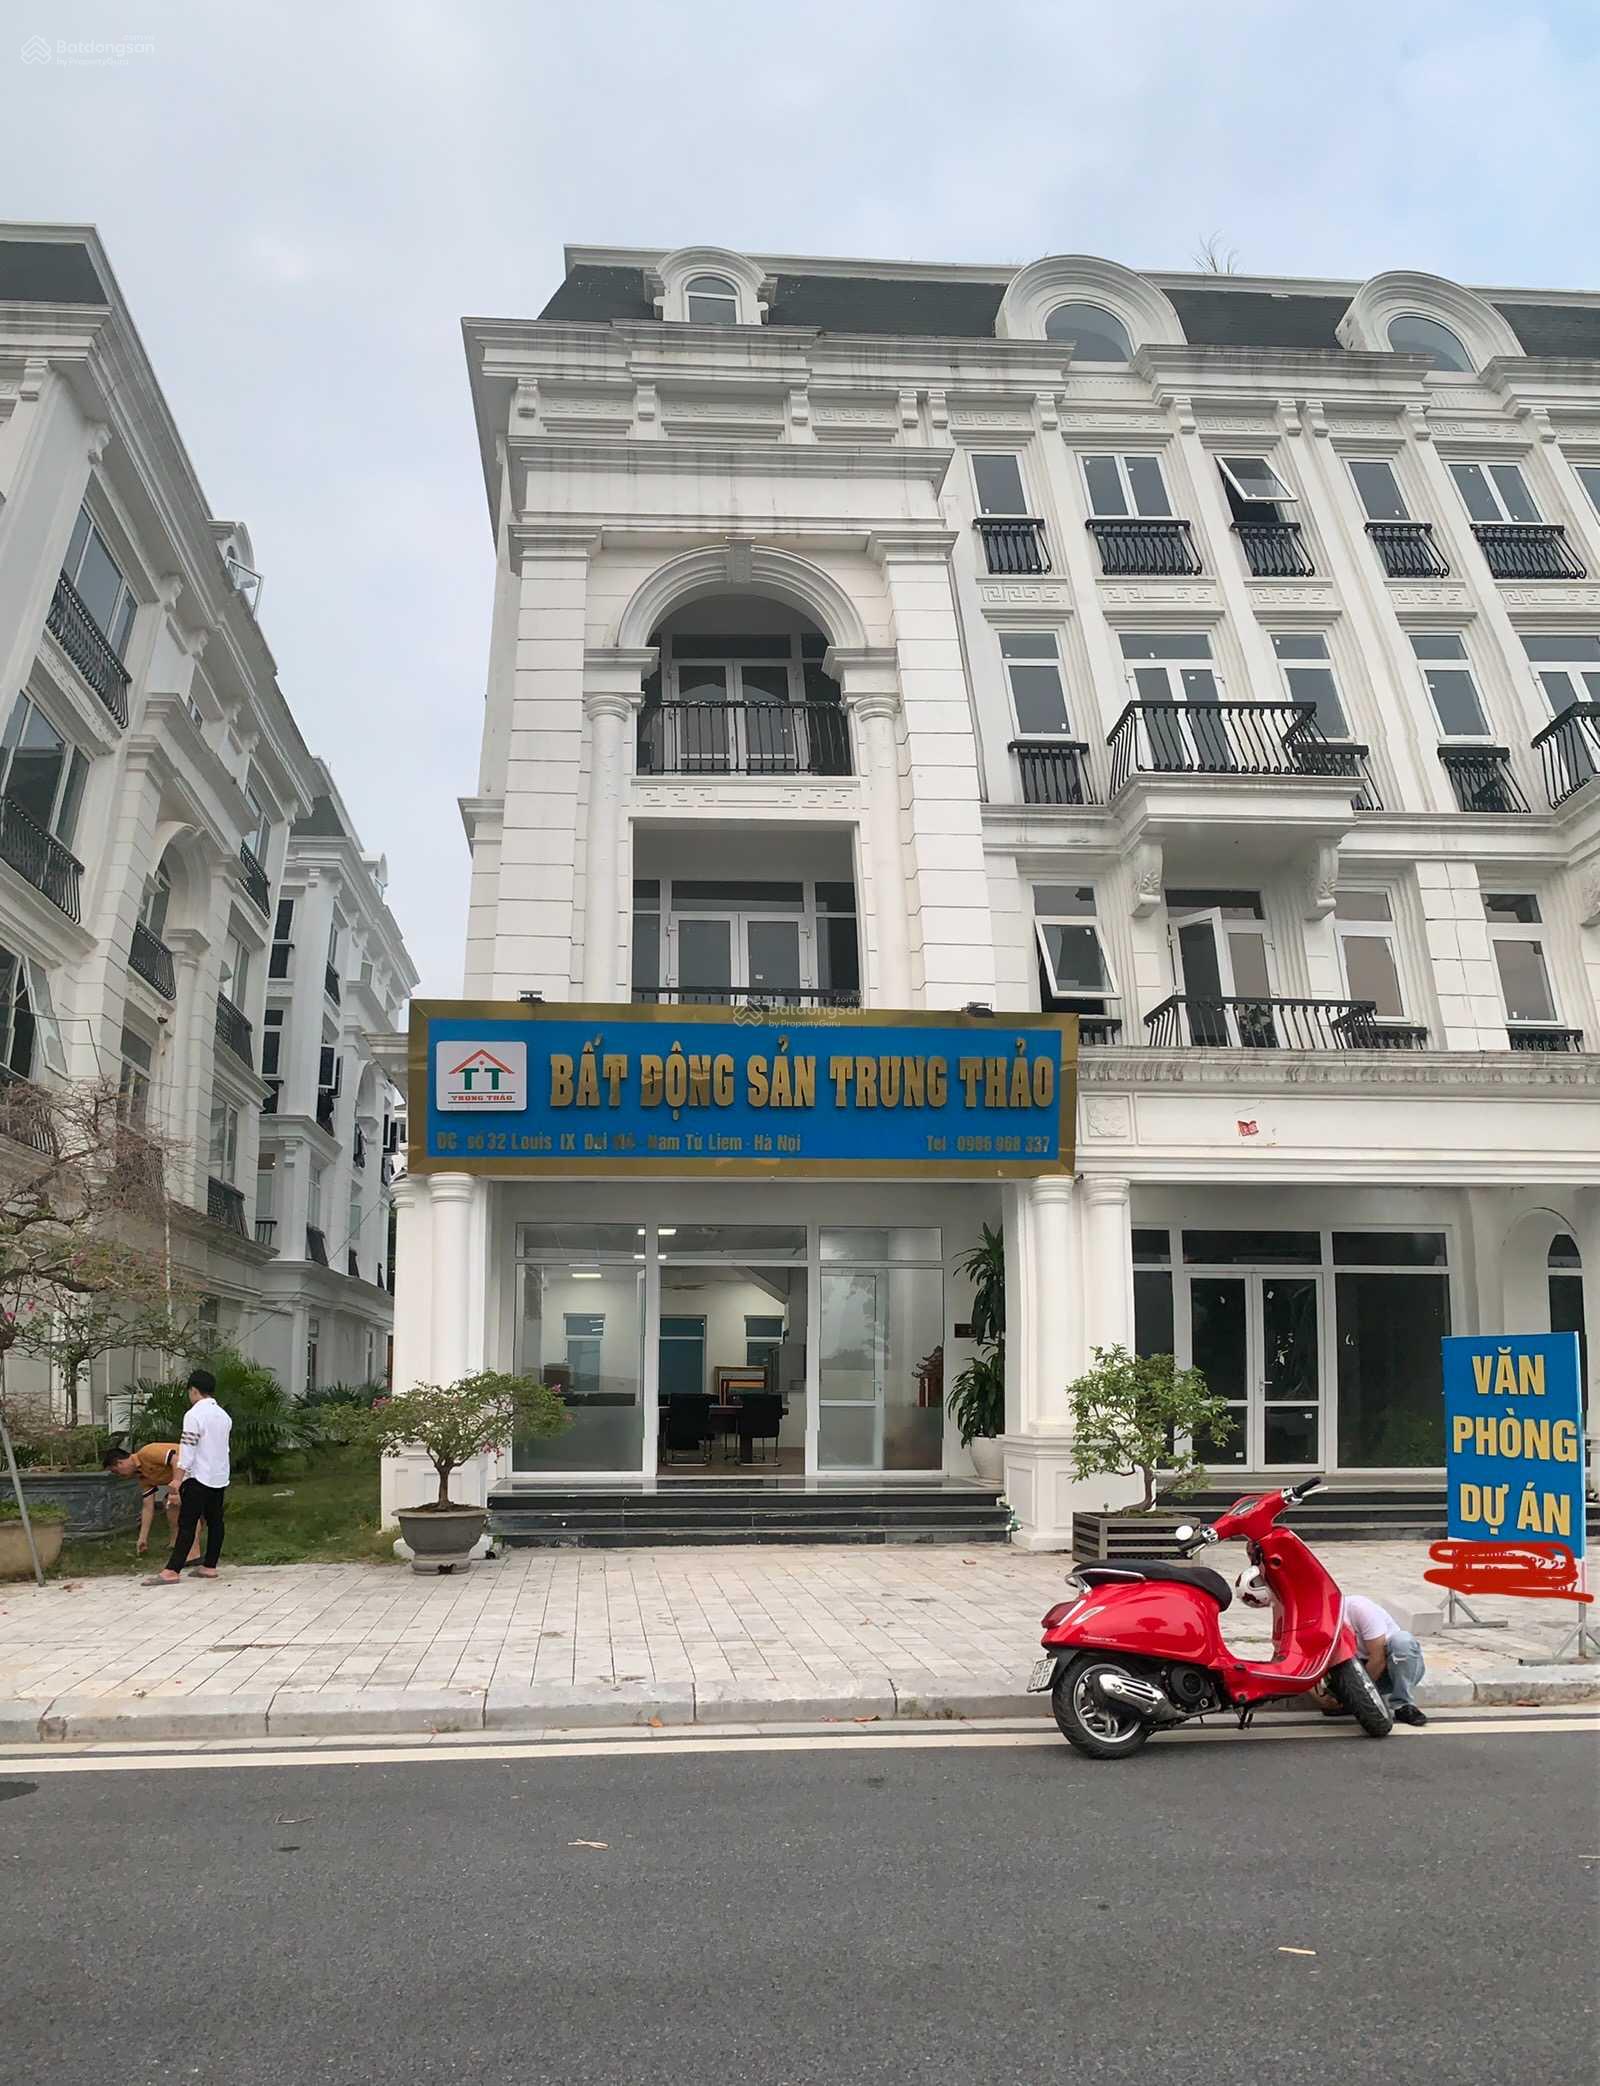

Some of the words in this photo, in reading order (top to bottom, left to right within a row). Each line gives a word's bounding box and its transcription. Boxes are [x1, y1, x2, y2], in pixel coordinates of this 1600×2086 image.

[550, 1033, 629, 1108] BẤT
[640, 1040, 736, 1121] ĐỘNG
[747, 1034, 817, 1108] SẢN
[829, 1056, 948, 1109] TRUNG
[959, 1037, 1054, 1109] THẢO
[487, 1132, 507, 1150] 32
[512, 1131, 552, 1150] Louis
[560, 1133, 576, 1150] IX
[1471, 1346, 1545, 1396] VĂN
[1452, 1408, 1578, 1463] PHÒNG
[1459, 1483, 1510, 1535] DỰ
[1516, 1483, 1571, 1537] ÁN
